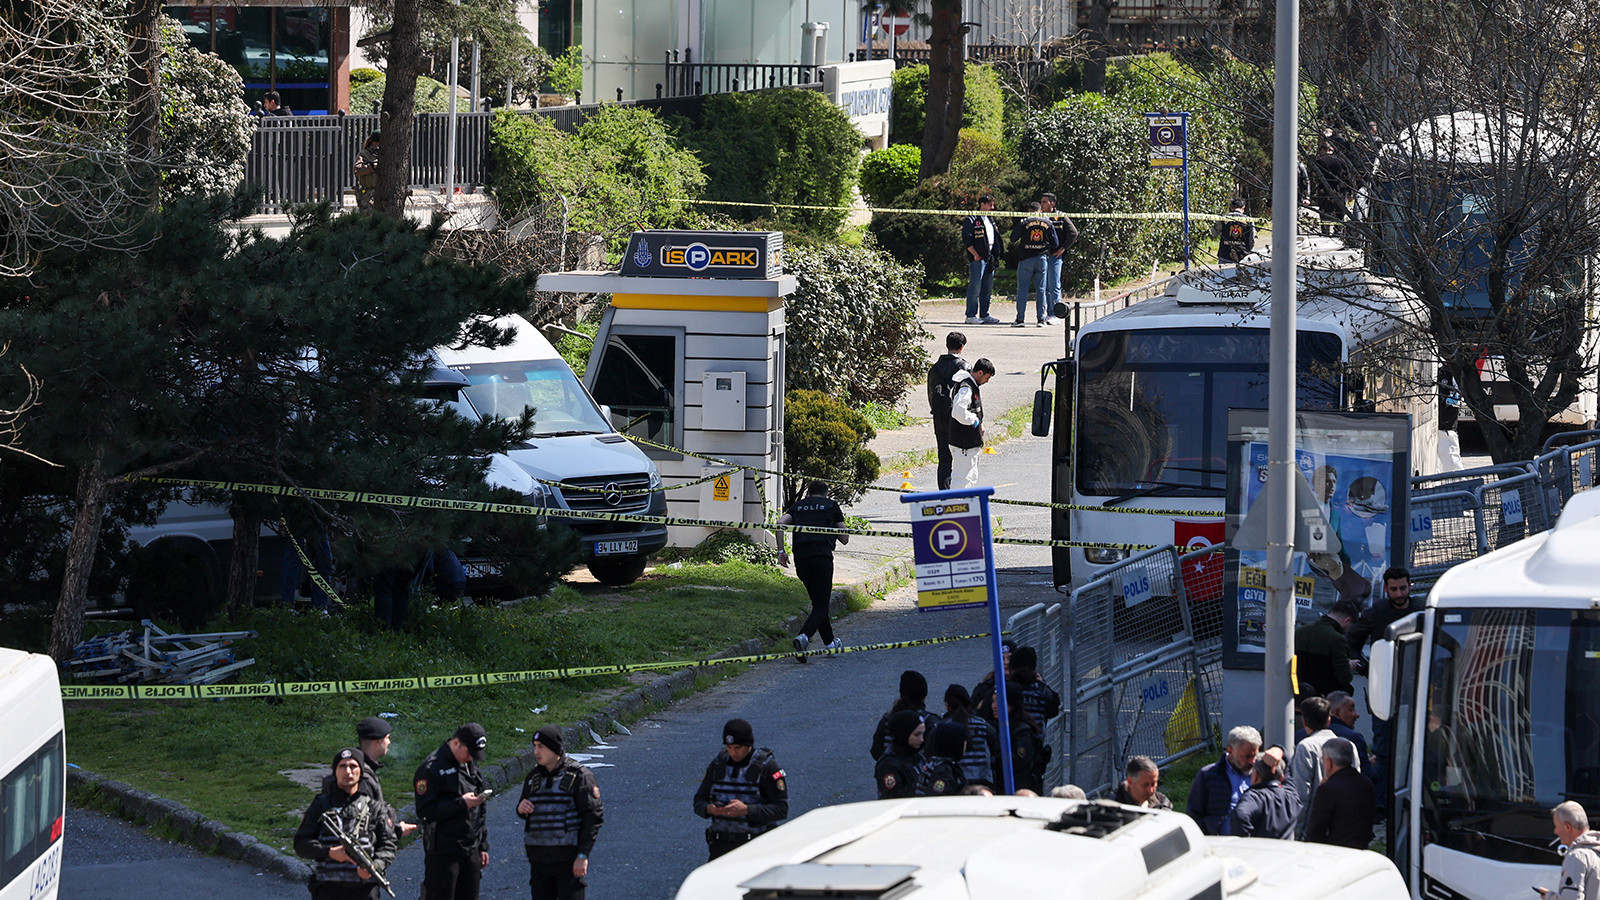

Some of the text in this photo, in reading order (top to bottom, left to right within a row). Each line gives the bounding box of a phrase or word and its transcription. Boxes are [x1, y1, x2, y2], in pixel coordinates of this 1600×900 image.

[598, 540, 637, 552] 34 LLY 402
[937, 529, 960, 550] P
